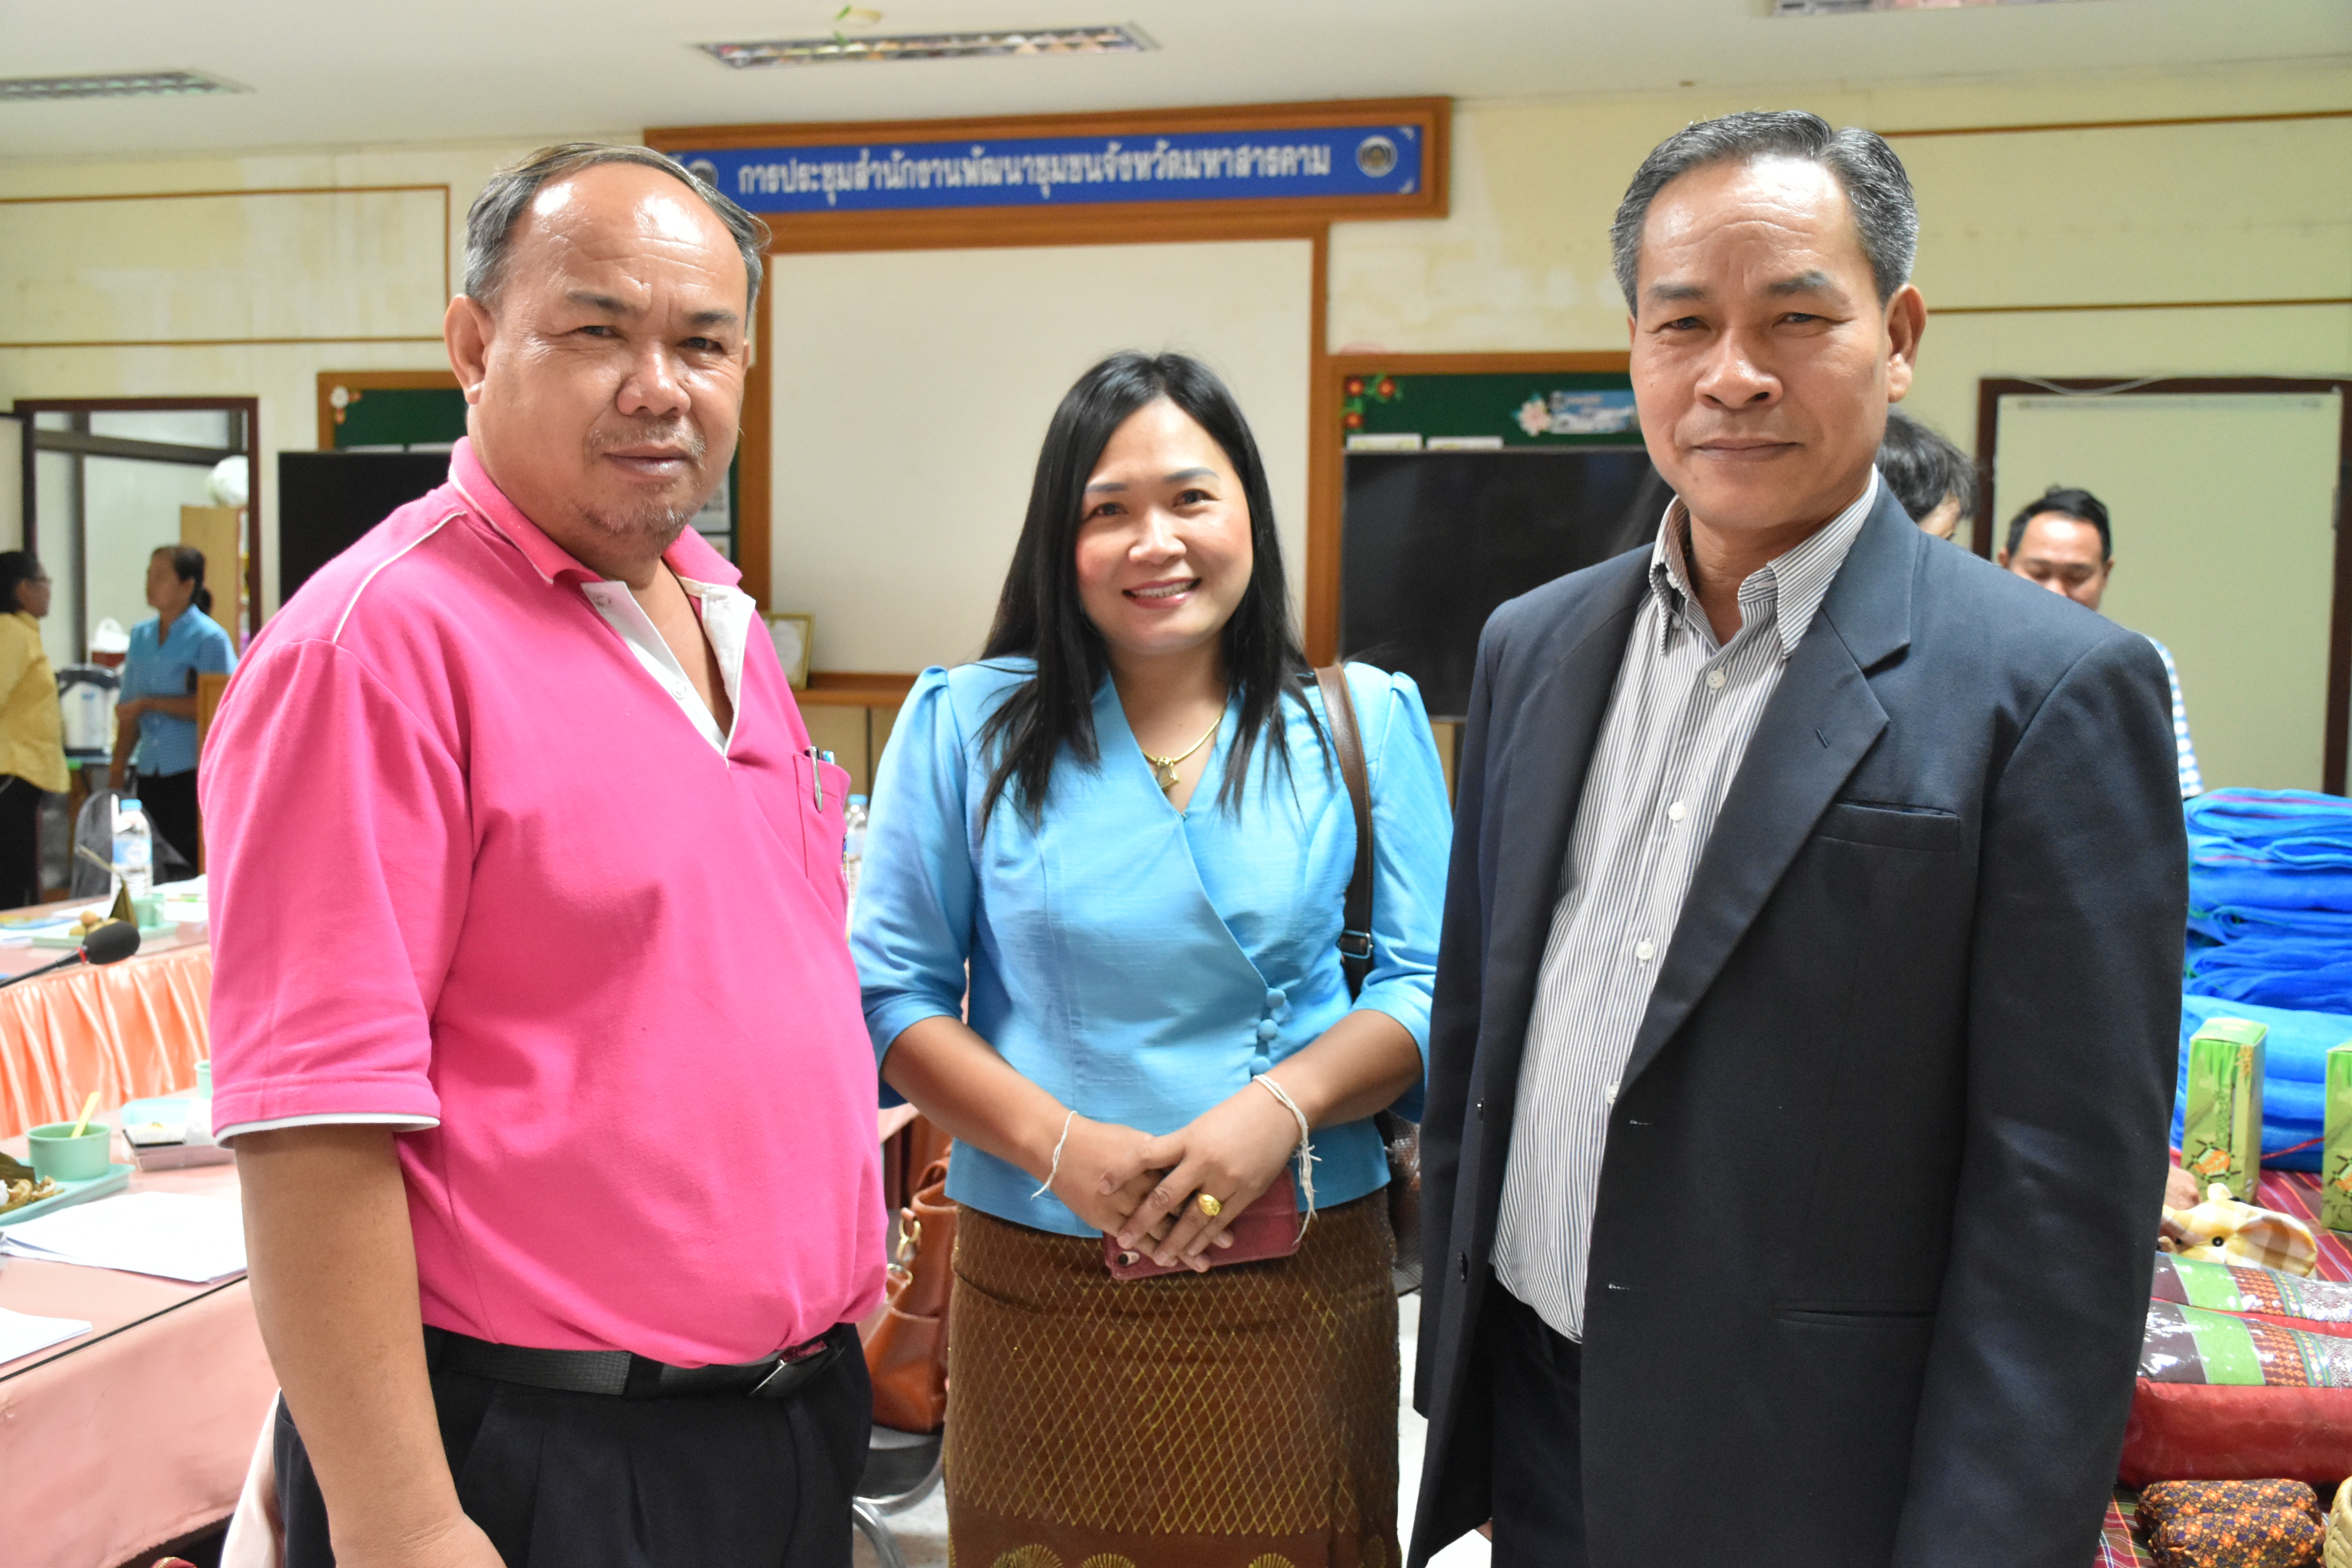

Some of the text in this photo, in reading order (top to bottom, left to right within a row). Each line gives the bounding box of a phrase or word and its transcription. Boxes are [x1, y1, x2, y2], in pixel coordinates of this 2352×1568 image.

[738, 139, 1331, 206] การประชุมสำนักงานพัฒนาชุมชนจังหวัดมหาสารคาม
